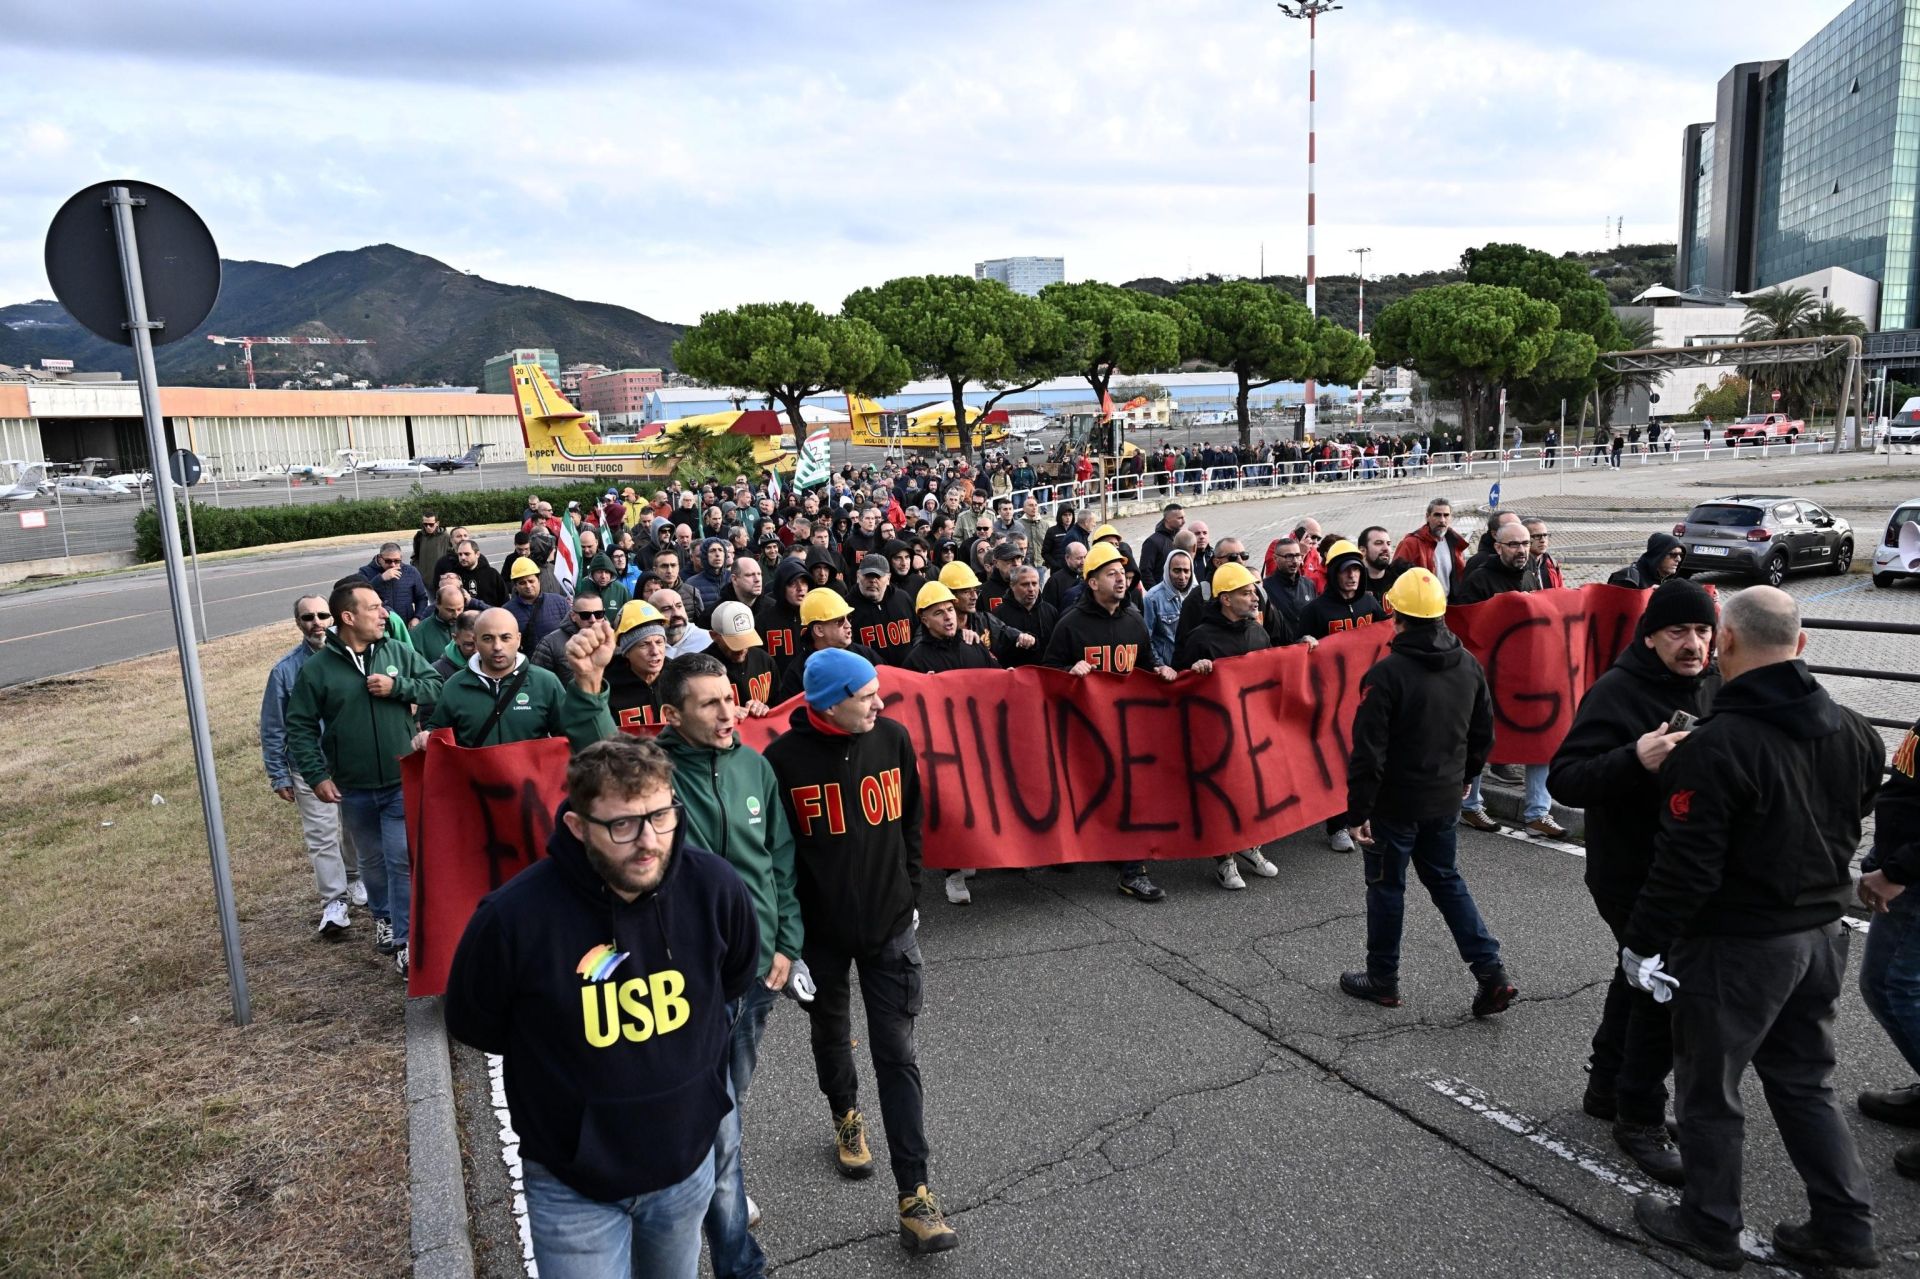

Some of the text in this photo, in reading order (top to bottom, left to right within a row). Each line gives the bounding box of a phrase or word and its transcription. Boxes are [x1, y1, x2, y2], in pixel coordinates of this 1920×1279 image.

[551, 463, 624, 472] VIGILI DEL FUOCO
[860, 618, 911, 649] FIOM
[581, 969, 691, 1049] USB
